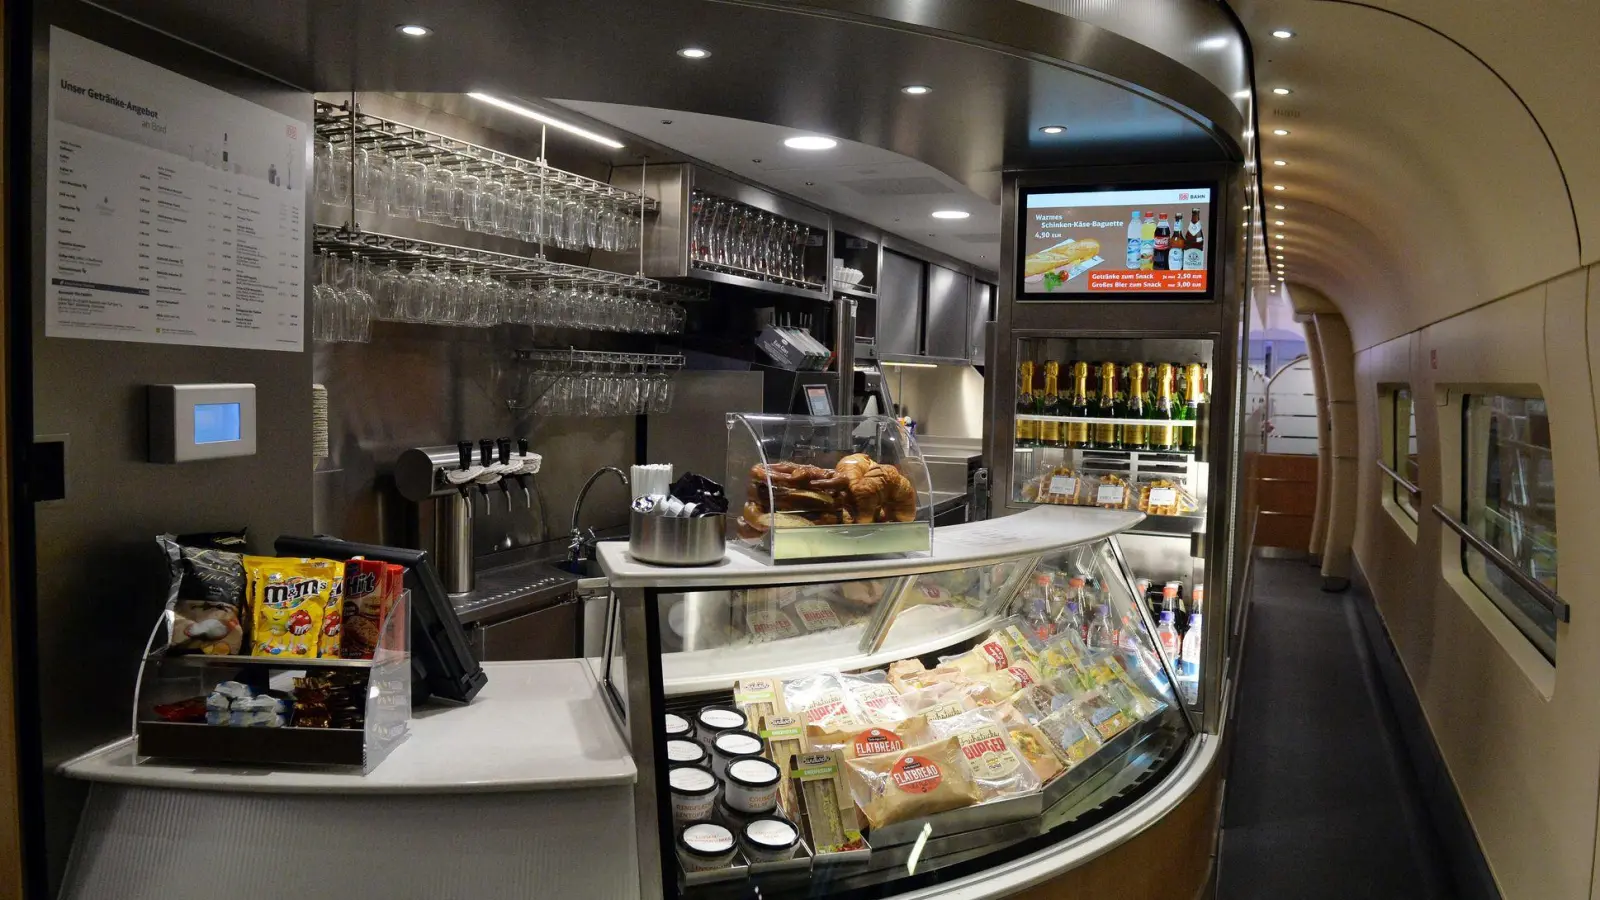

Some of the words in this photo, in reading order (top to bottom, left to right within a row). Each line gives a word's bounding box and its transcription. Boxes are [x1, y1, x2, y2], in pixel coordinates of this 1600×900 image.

[61, 79, 86, 96] Unser
[88, 88, 158, 119] Getränke-Angebot
[142, 120, 150, 128] an
[151, 122, 167, 134] Bord
[1041, 220, 1124, 230] Schinken-Käse-Baguette
[1092, 281, 1113, 289] Großes
[1177, 281, 1191, 289] 3,00
[347, 572, 376, 596] Hit
[856, 740, 901, 754] FLATBREAD
[962, 737, 1007, 760] BURGER
[893, 764, 938, 784] FLATBREAD
